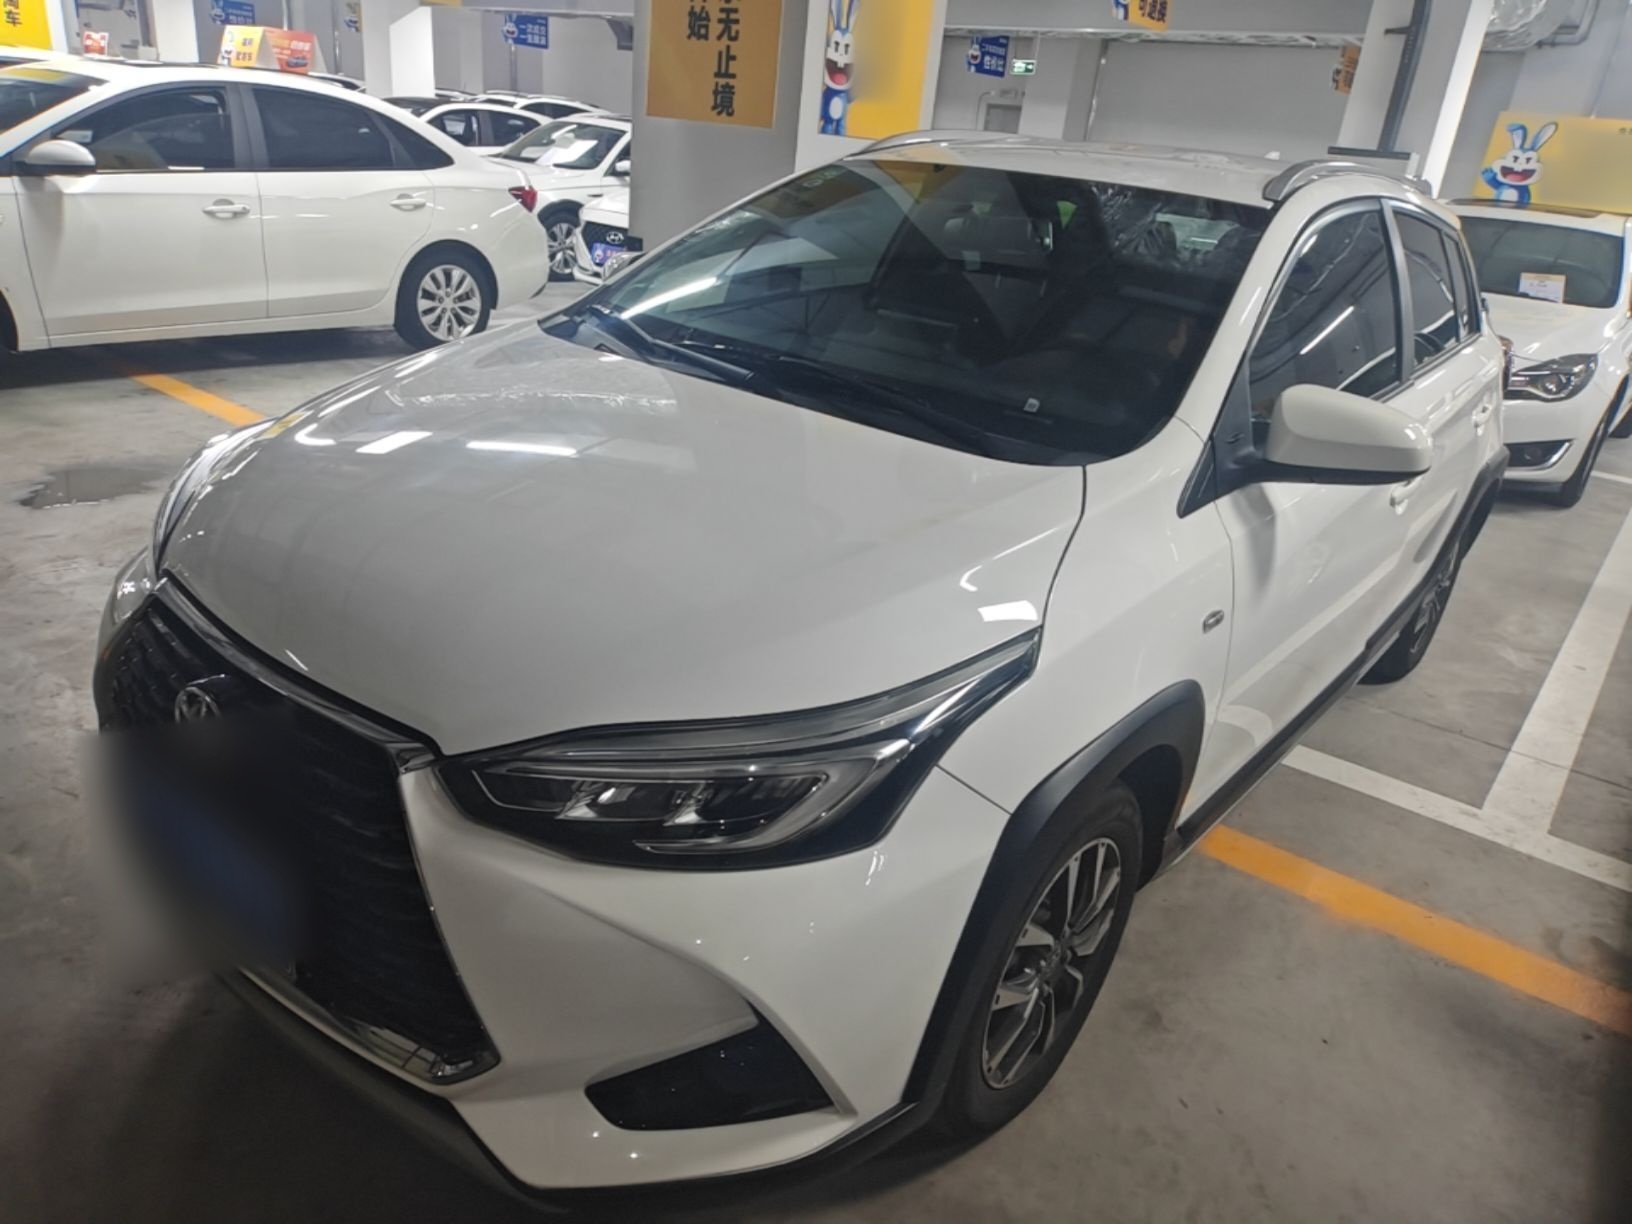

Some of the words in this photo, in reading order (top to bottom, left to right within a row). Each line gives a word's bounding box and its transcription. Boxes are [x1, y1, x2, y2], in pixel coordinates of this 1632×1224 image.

[686, 0, 711, 41] 始
[711, 0, 740, 117] 无止境
